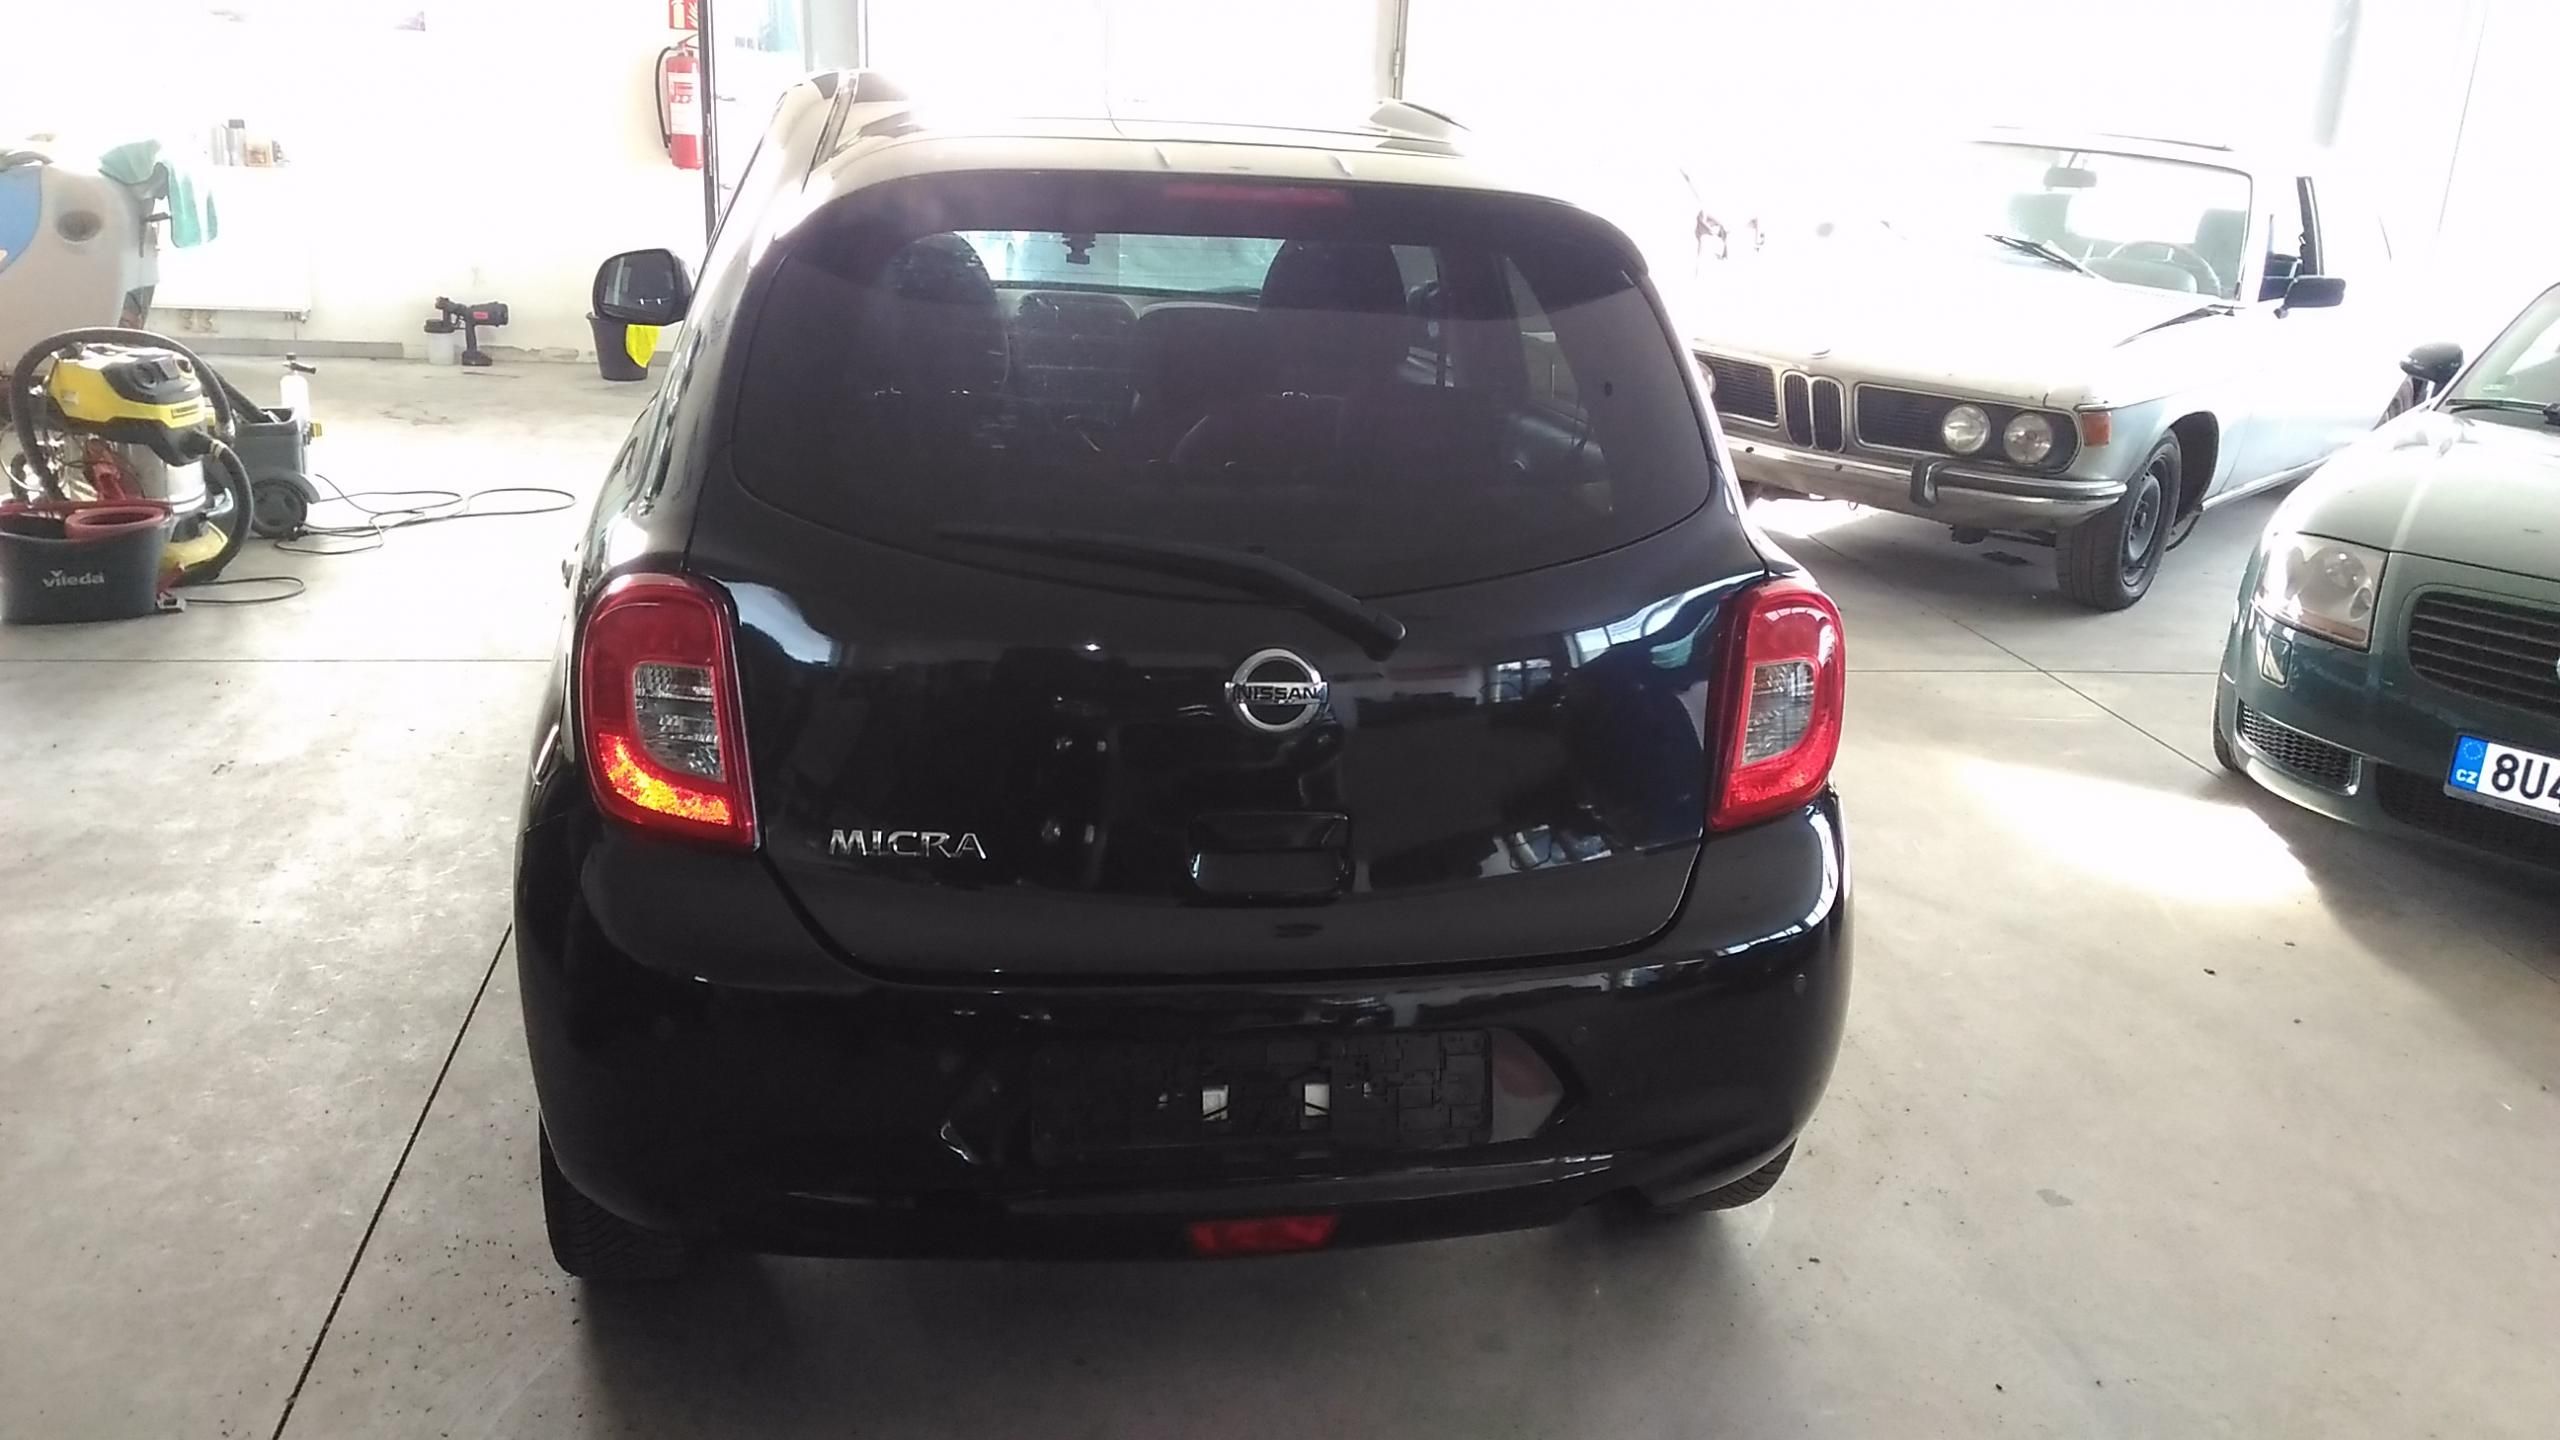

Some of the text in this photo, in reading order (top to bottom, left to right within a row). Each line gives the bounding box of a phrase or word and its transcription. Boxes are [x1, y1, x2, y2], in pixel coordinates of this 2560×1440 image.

[1235, 685, 1317, 700] NISSAN
[2456, 769, 2478, 784] CZ
[830, 829, 987, 859] MICRA
